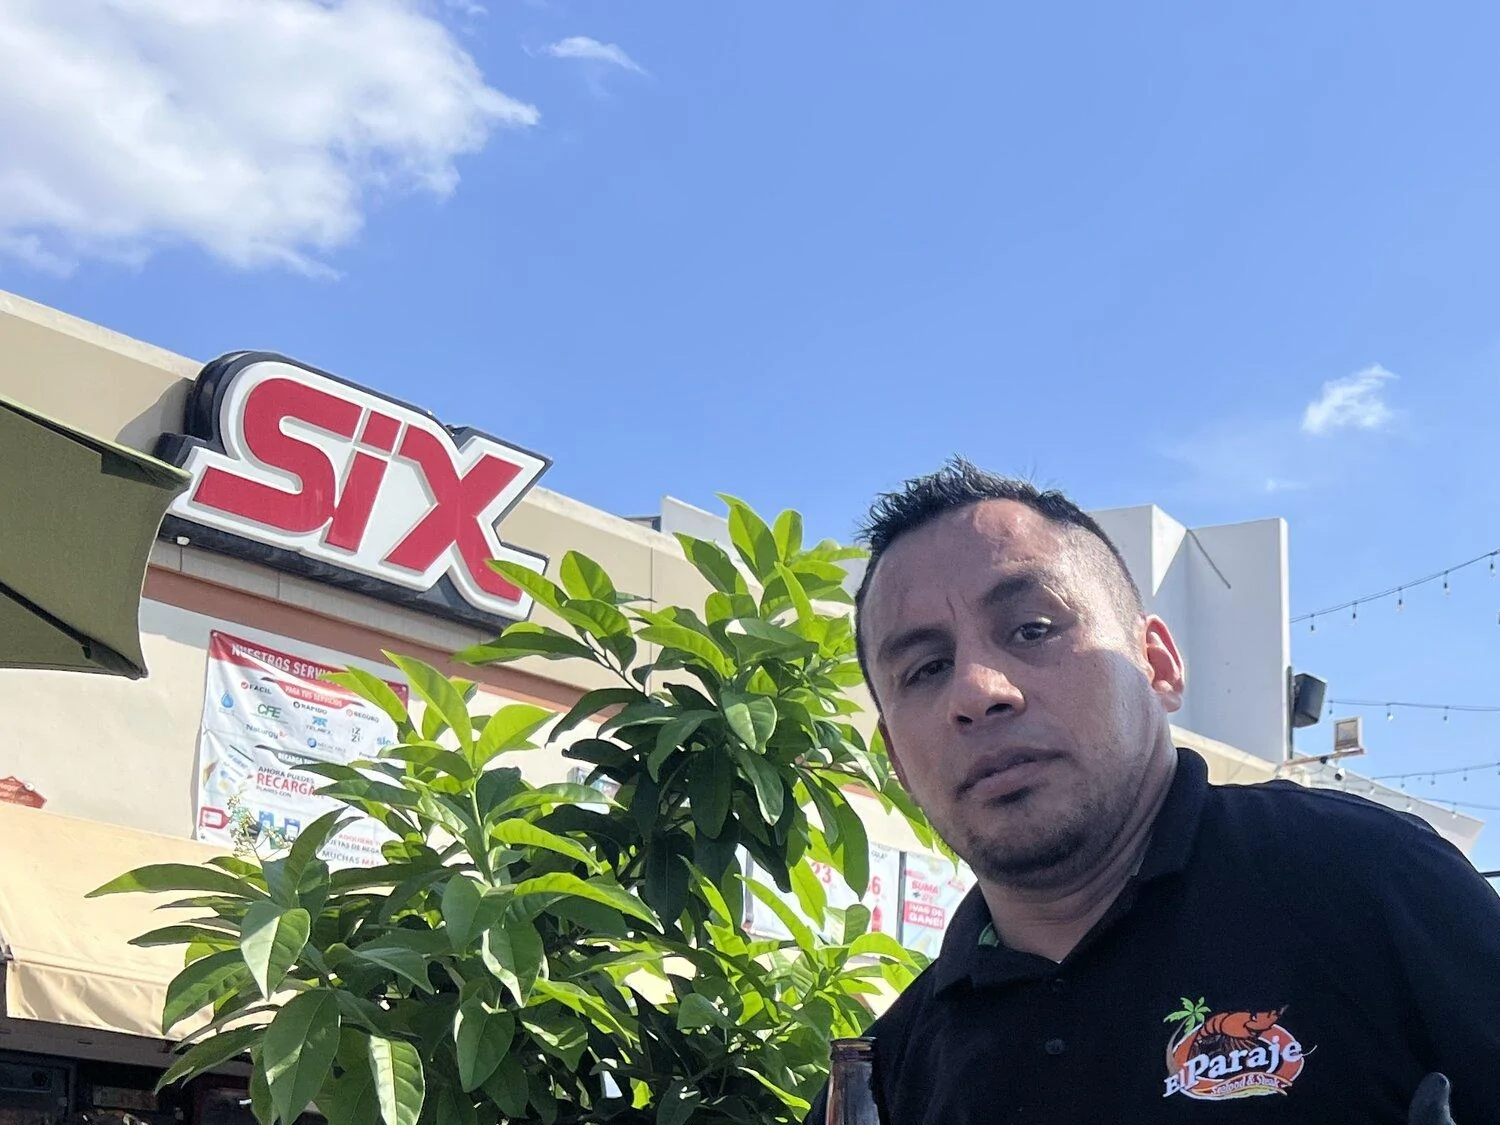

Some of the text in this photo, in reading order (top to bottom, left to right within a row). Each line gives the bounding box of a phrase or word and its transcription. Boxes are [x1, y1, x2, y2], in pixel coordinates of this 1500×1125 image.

[257, 704, 282, 719] CFE
[258, 766, 285, 778] AHORA
[321, 850, 361, 865] MUCHAS
[1163, 1035, 1302, 1097] El Paraje
